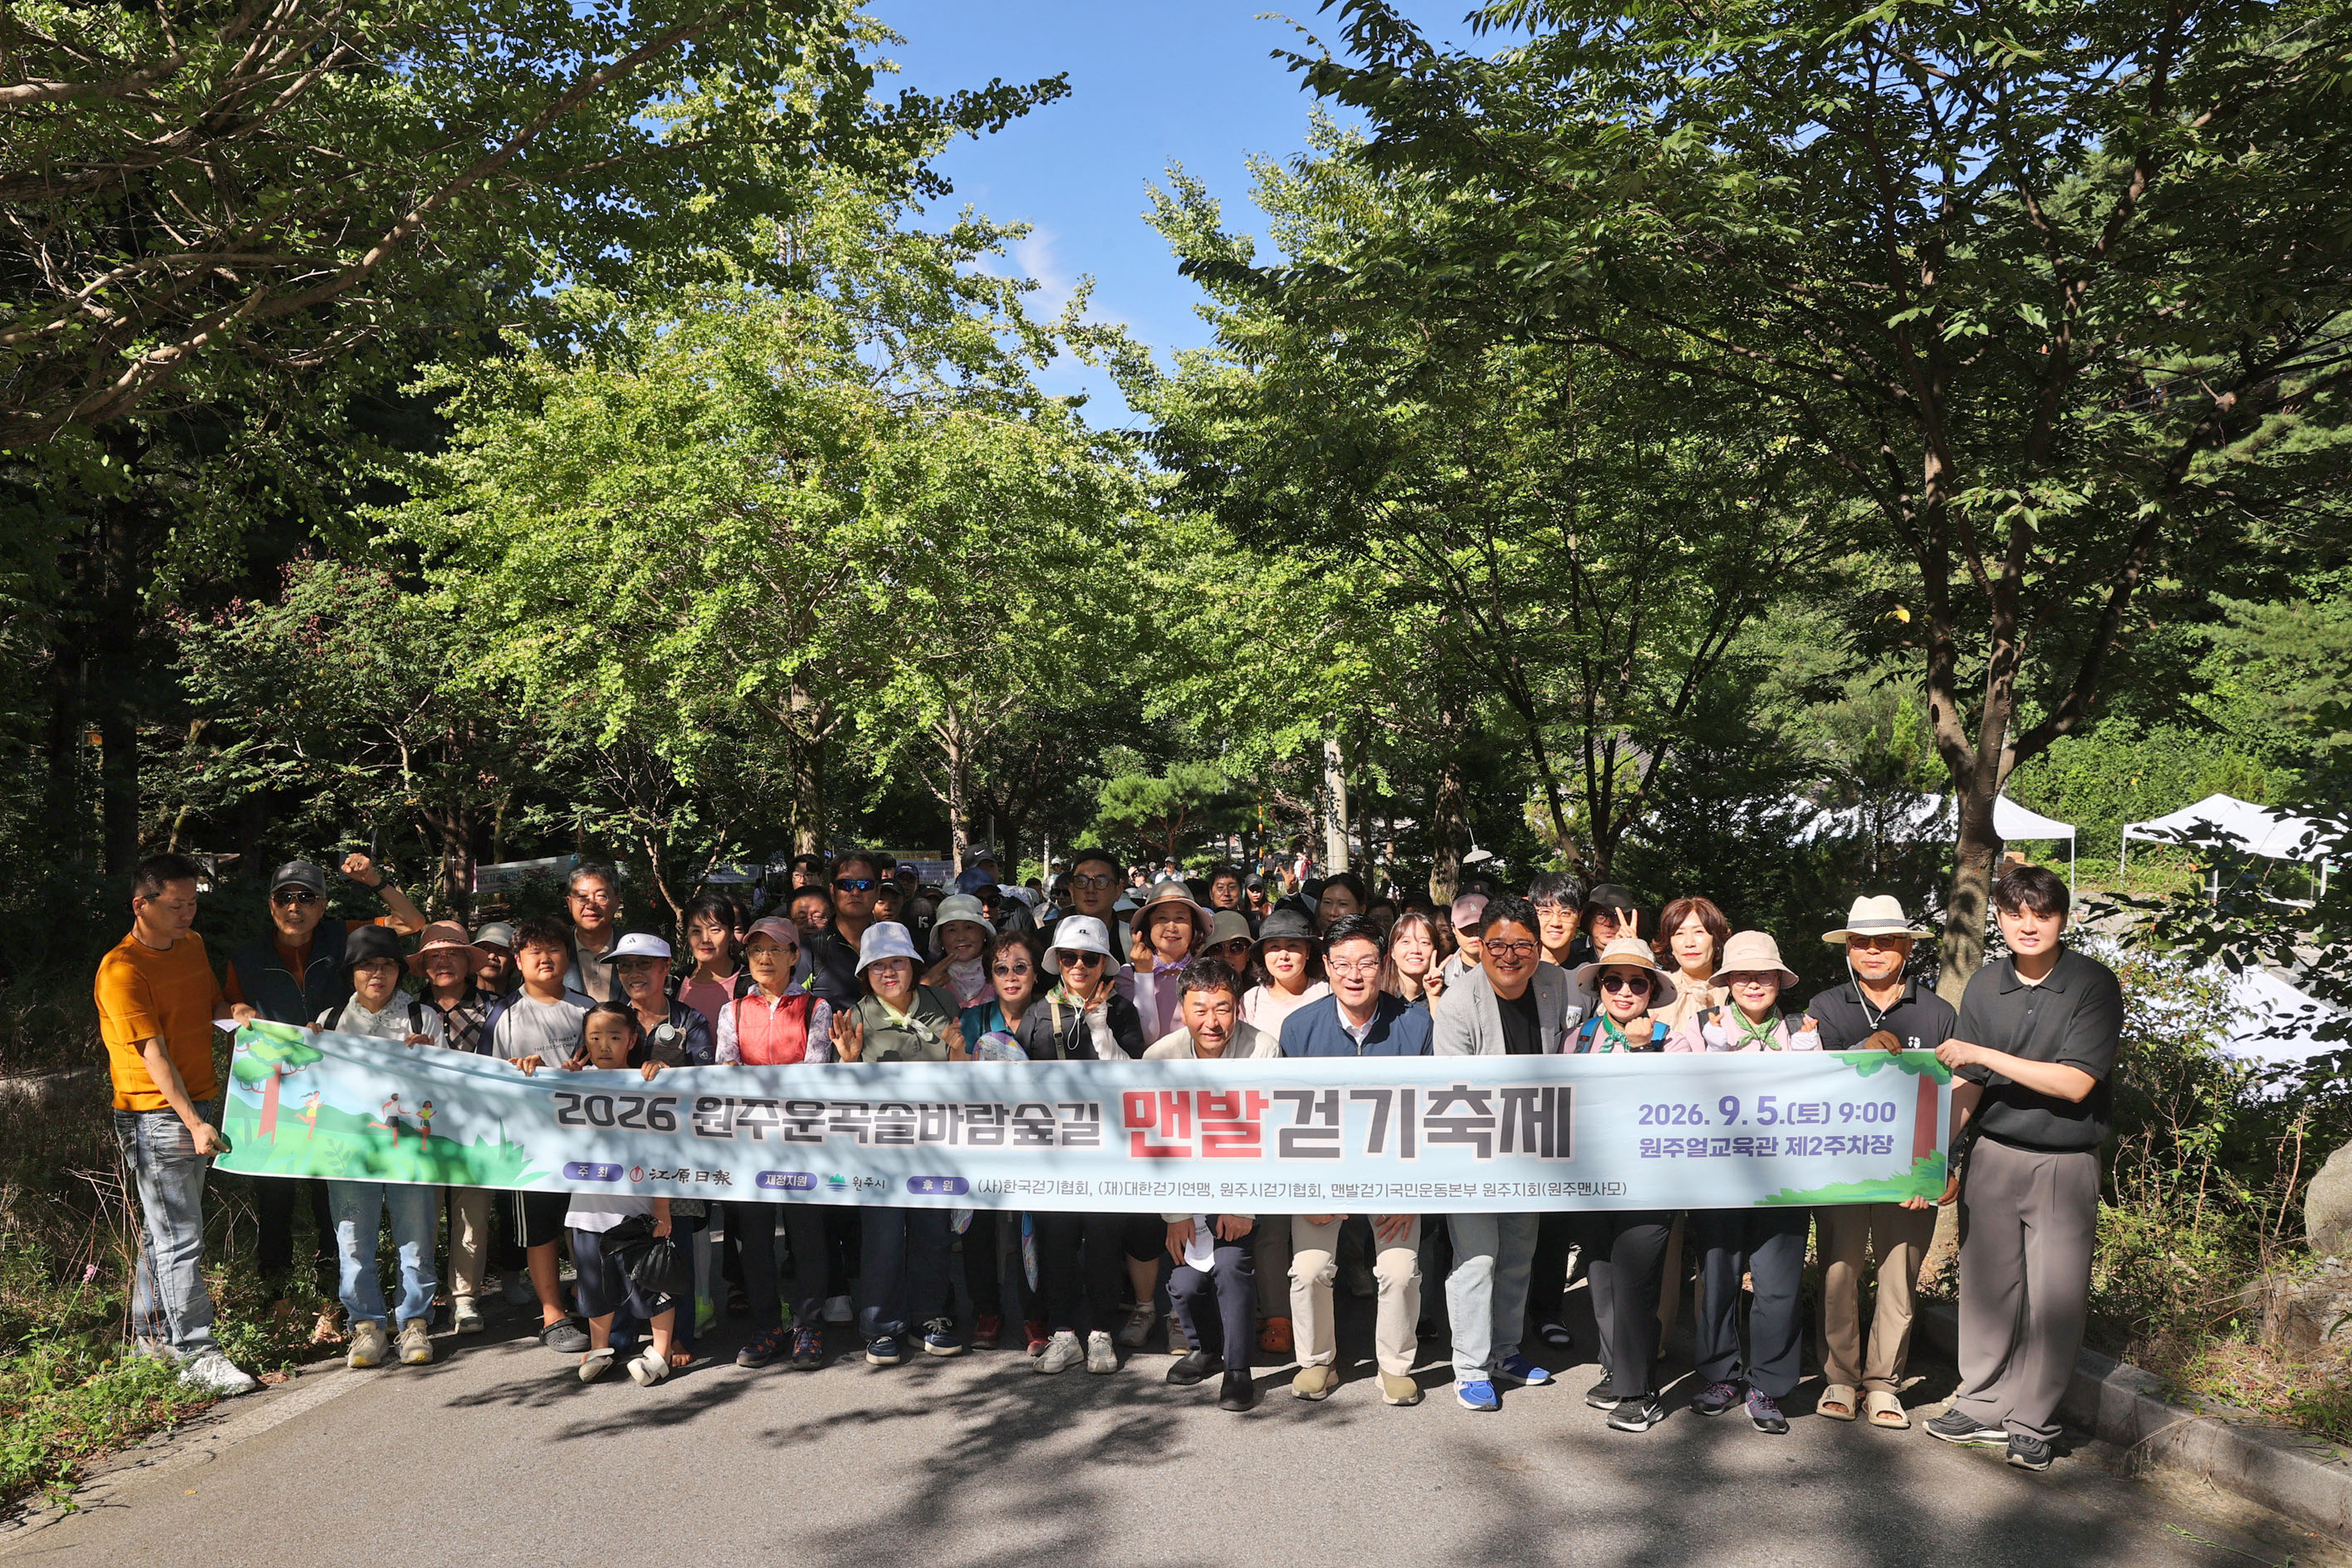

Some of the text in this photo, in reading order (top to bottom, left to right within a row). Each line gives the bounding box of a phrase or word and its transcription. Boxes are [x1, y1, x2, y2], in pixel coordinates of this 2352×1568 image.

[555, 1085, 1571, 1159] 2026 원주운곡솔바람숲길 맨발걷기축제
[1639, 1103, 1711, 1125] 2026.
[1838, 1101, 1897, 1123] 9:00
[1639, 1134, 1894, 1158] 원주얼교육관 제2주차장
[649, 1168, 733, 1186] 江原日報
[765, 1174, 808, 1187] 재정지원
[852, 1176, 886, 1191] 원주시
[978, 1179, 1627, 1198] (사)한국걷기협회, (재)대한걷기연맹, 원주시걷기협회, 맨발걷기국민운동본부 원주지회(원주맨사모)
